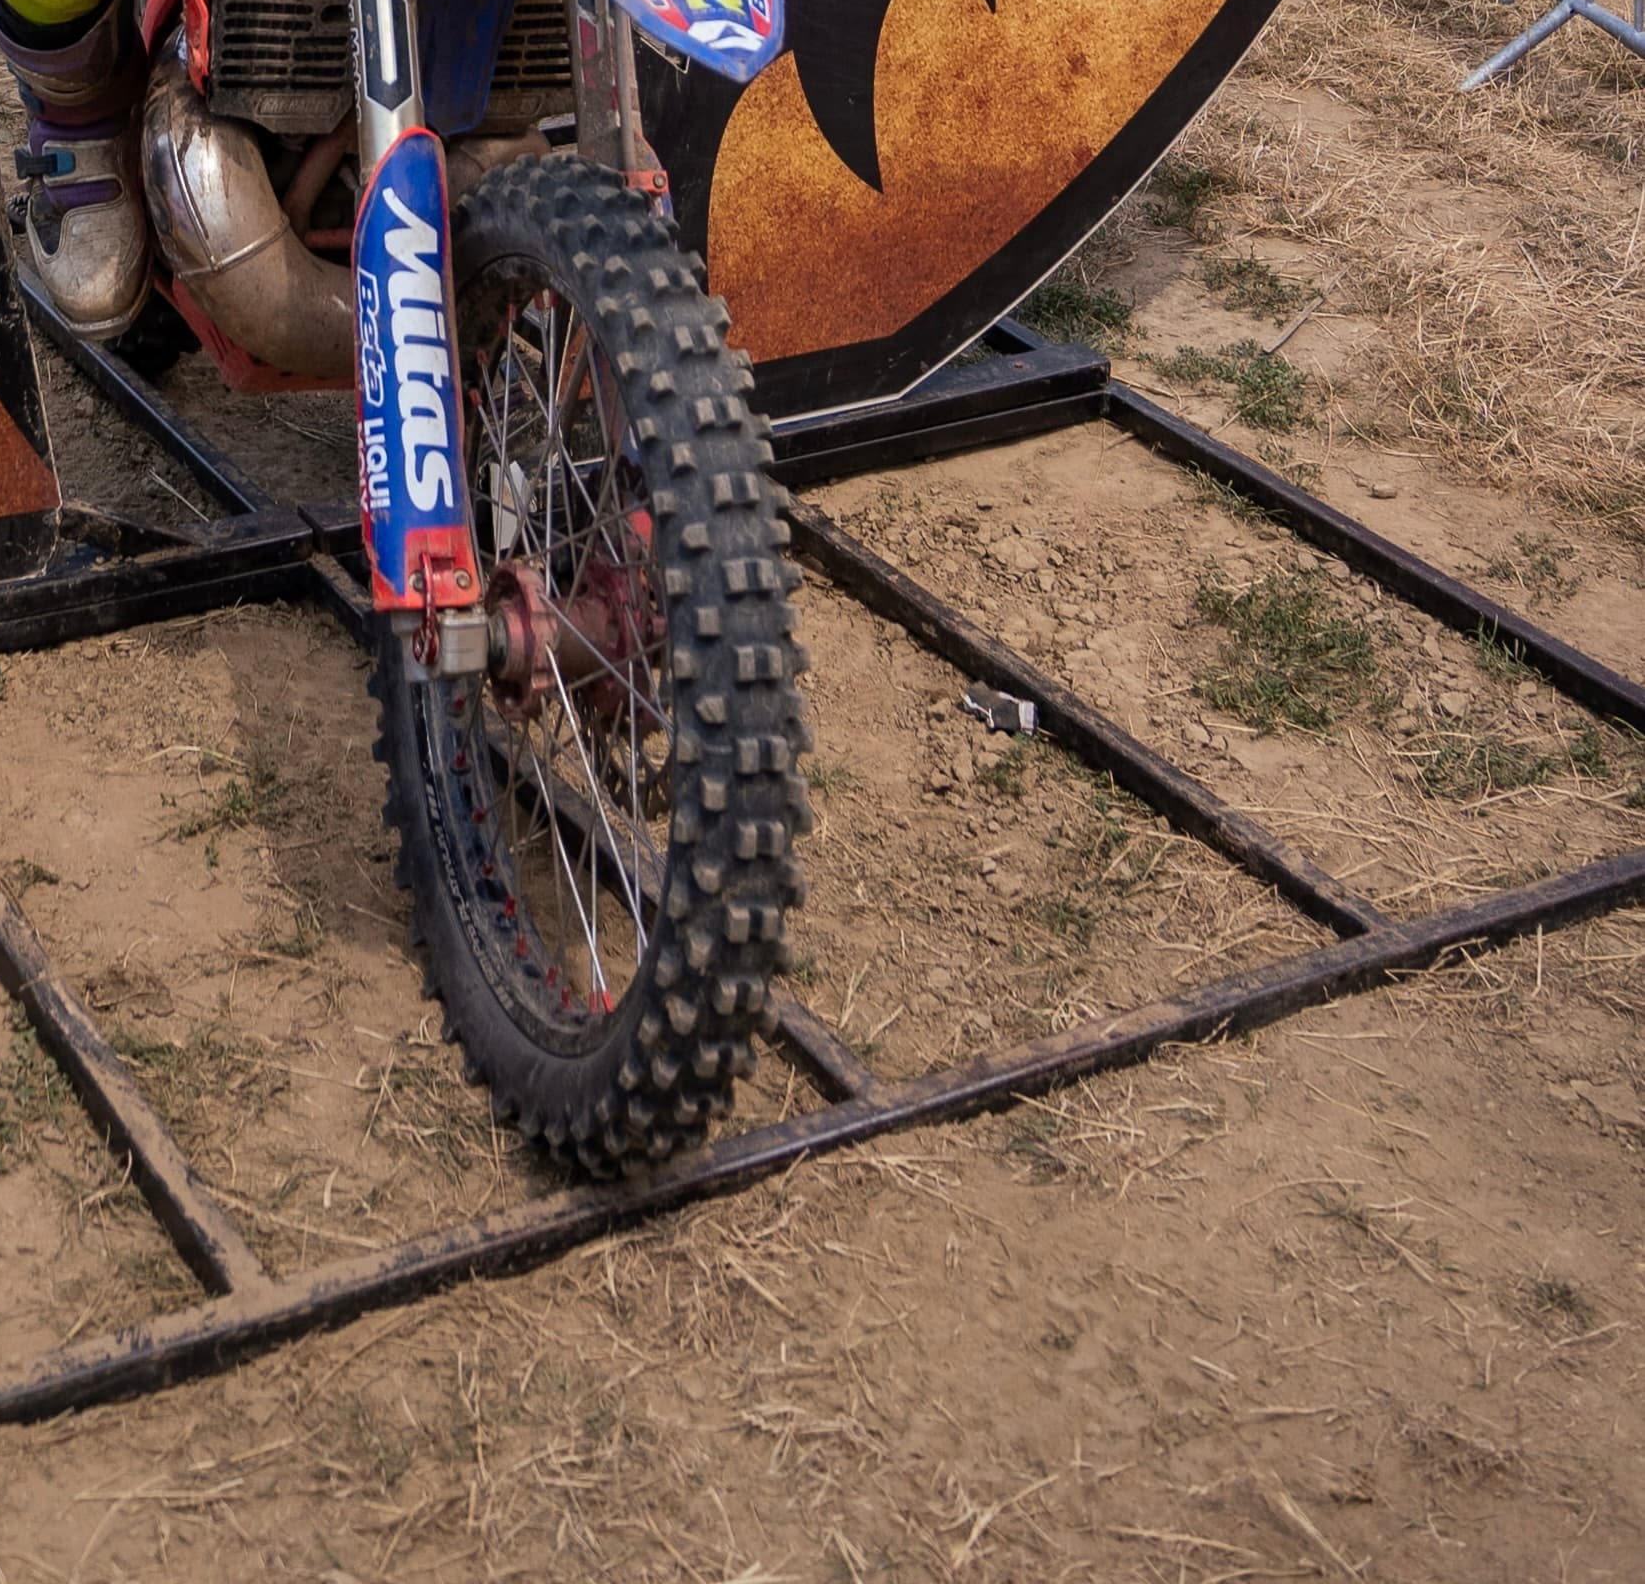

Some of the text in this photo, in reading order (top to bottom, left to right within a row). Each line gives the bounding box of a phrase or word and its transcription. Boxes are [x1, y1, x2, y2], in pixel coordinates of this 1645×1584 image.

[357, 267, 389, 409] Beta
[382, 187, 455, 513] Mitas
[363, 418, 391, 511] LIQUI
